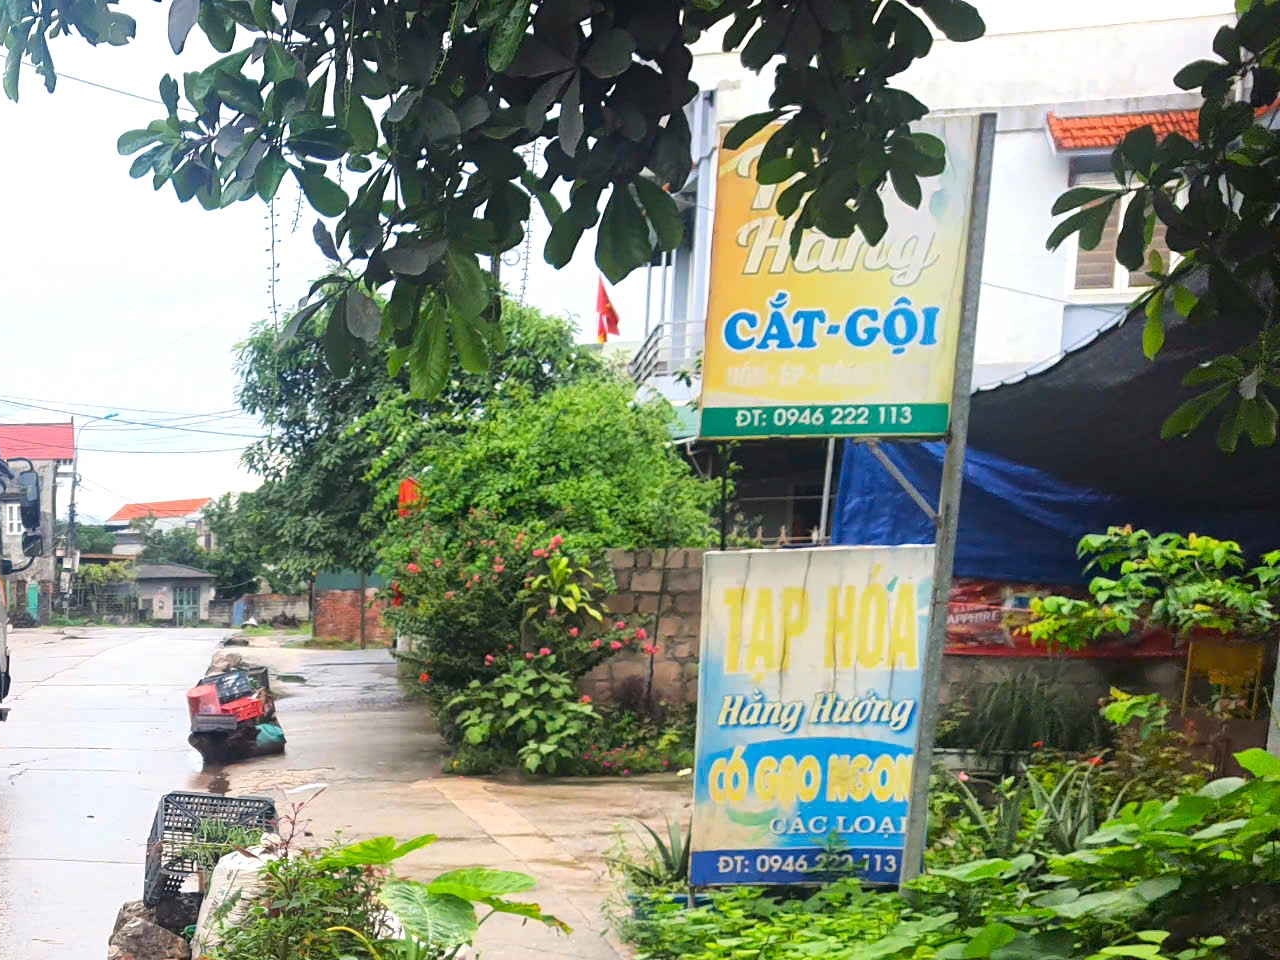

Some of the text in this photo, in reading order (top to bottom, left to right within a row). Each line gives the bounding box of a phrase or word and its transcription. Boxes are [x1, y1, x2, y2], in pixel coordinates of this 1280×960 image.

[723, 291, 941, 355] CẮT-GỘI
[735, 405, 913, 428] ĐT: 0946 222 113
[723, 563, 918, 682] TẠP HÓA
[946, 609, 1001, 626] APPHIRE
[708, 746, 750, 803] CÓ
[769, 811, 827, 835] CÁC
[717, 855, 750, 874] ĐT:
[755, 853, 808, 874] 0946
[861, 853, 897, 873] 113
